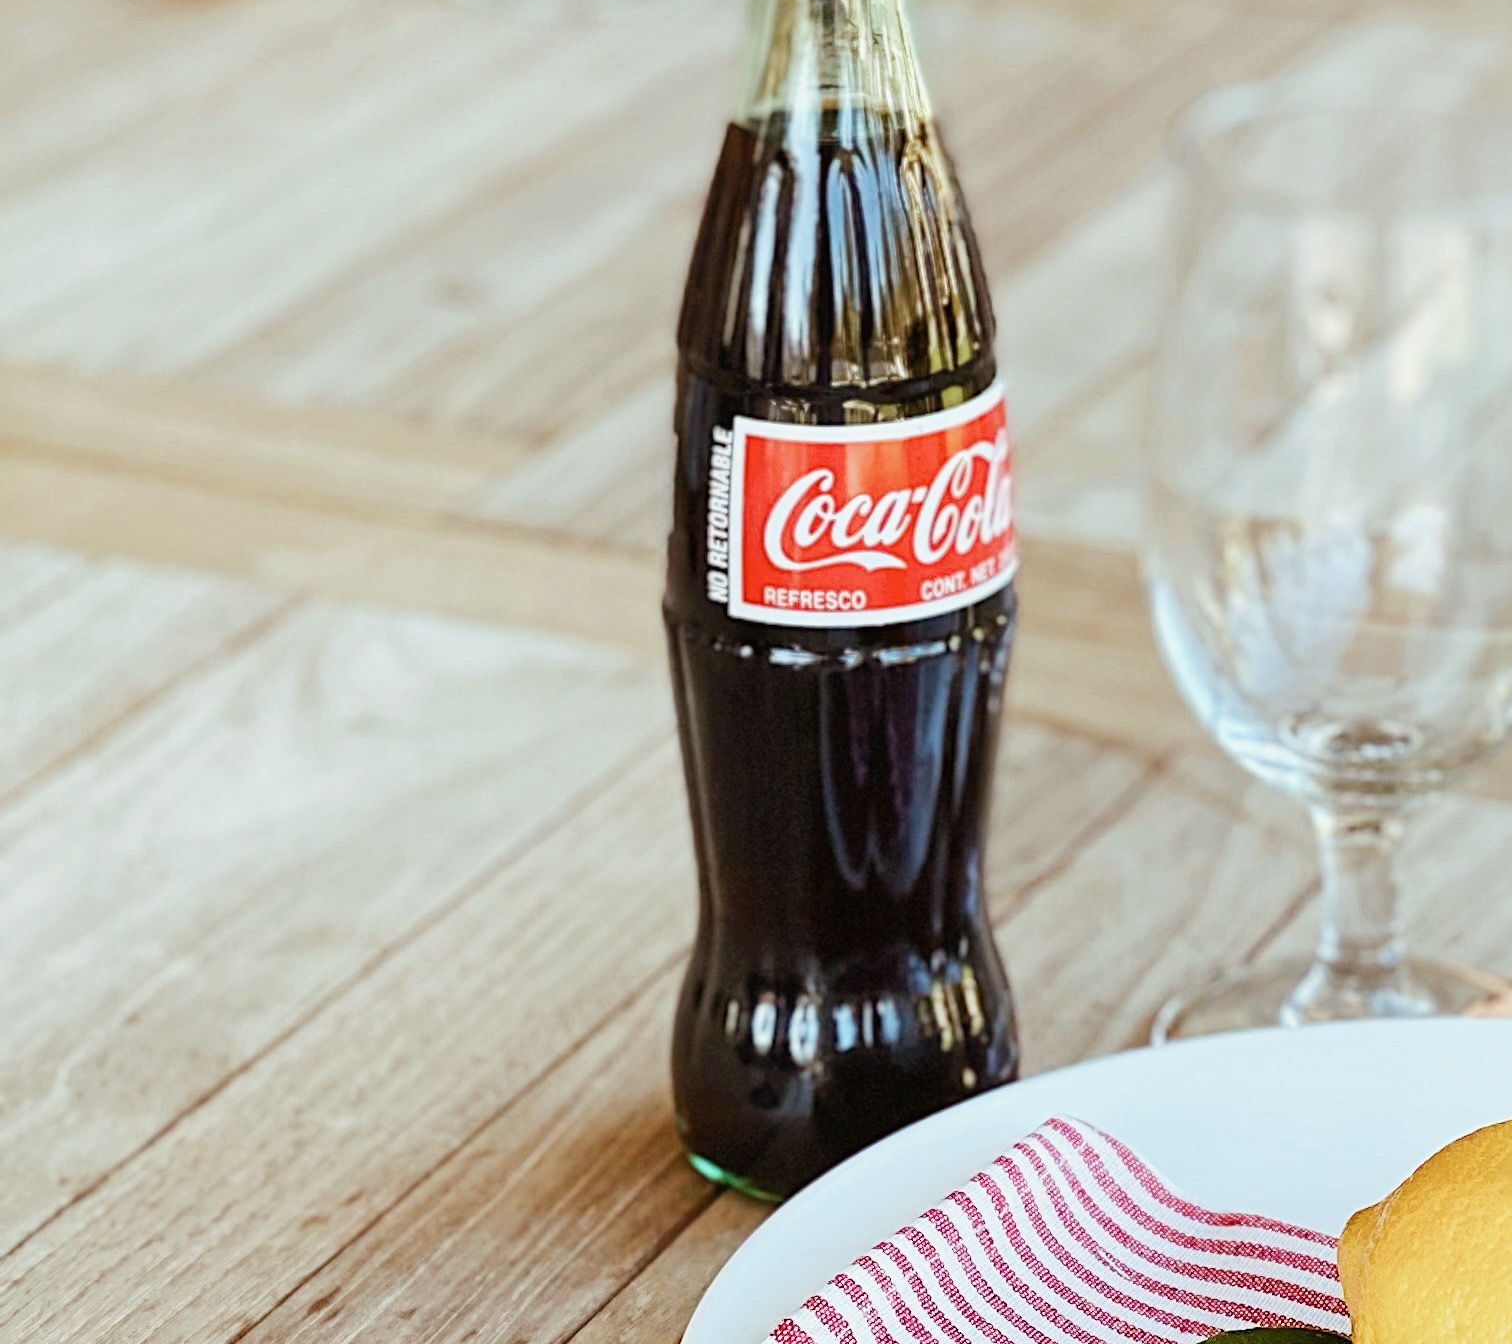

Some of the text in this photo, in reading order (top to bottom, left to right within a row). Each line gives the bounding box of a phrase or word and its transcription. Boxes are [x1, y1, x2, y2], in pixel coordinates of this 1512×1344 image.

[706, 425, 733, 604] NO RETORNABLE
[763, 587, 867, 611] REFRESCO
[920, 571, 967, 601] CONT.
